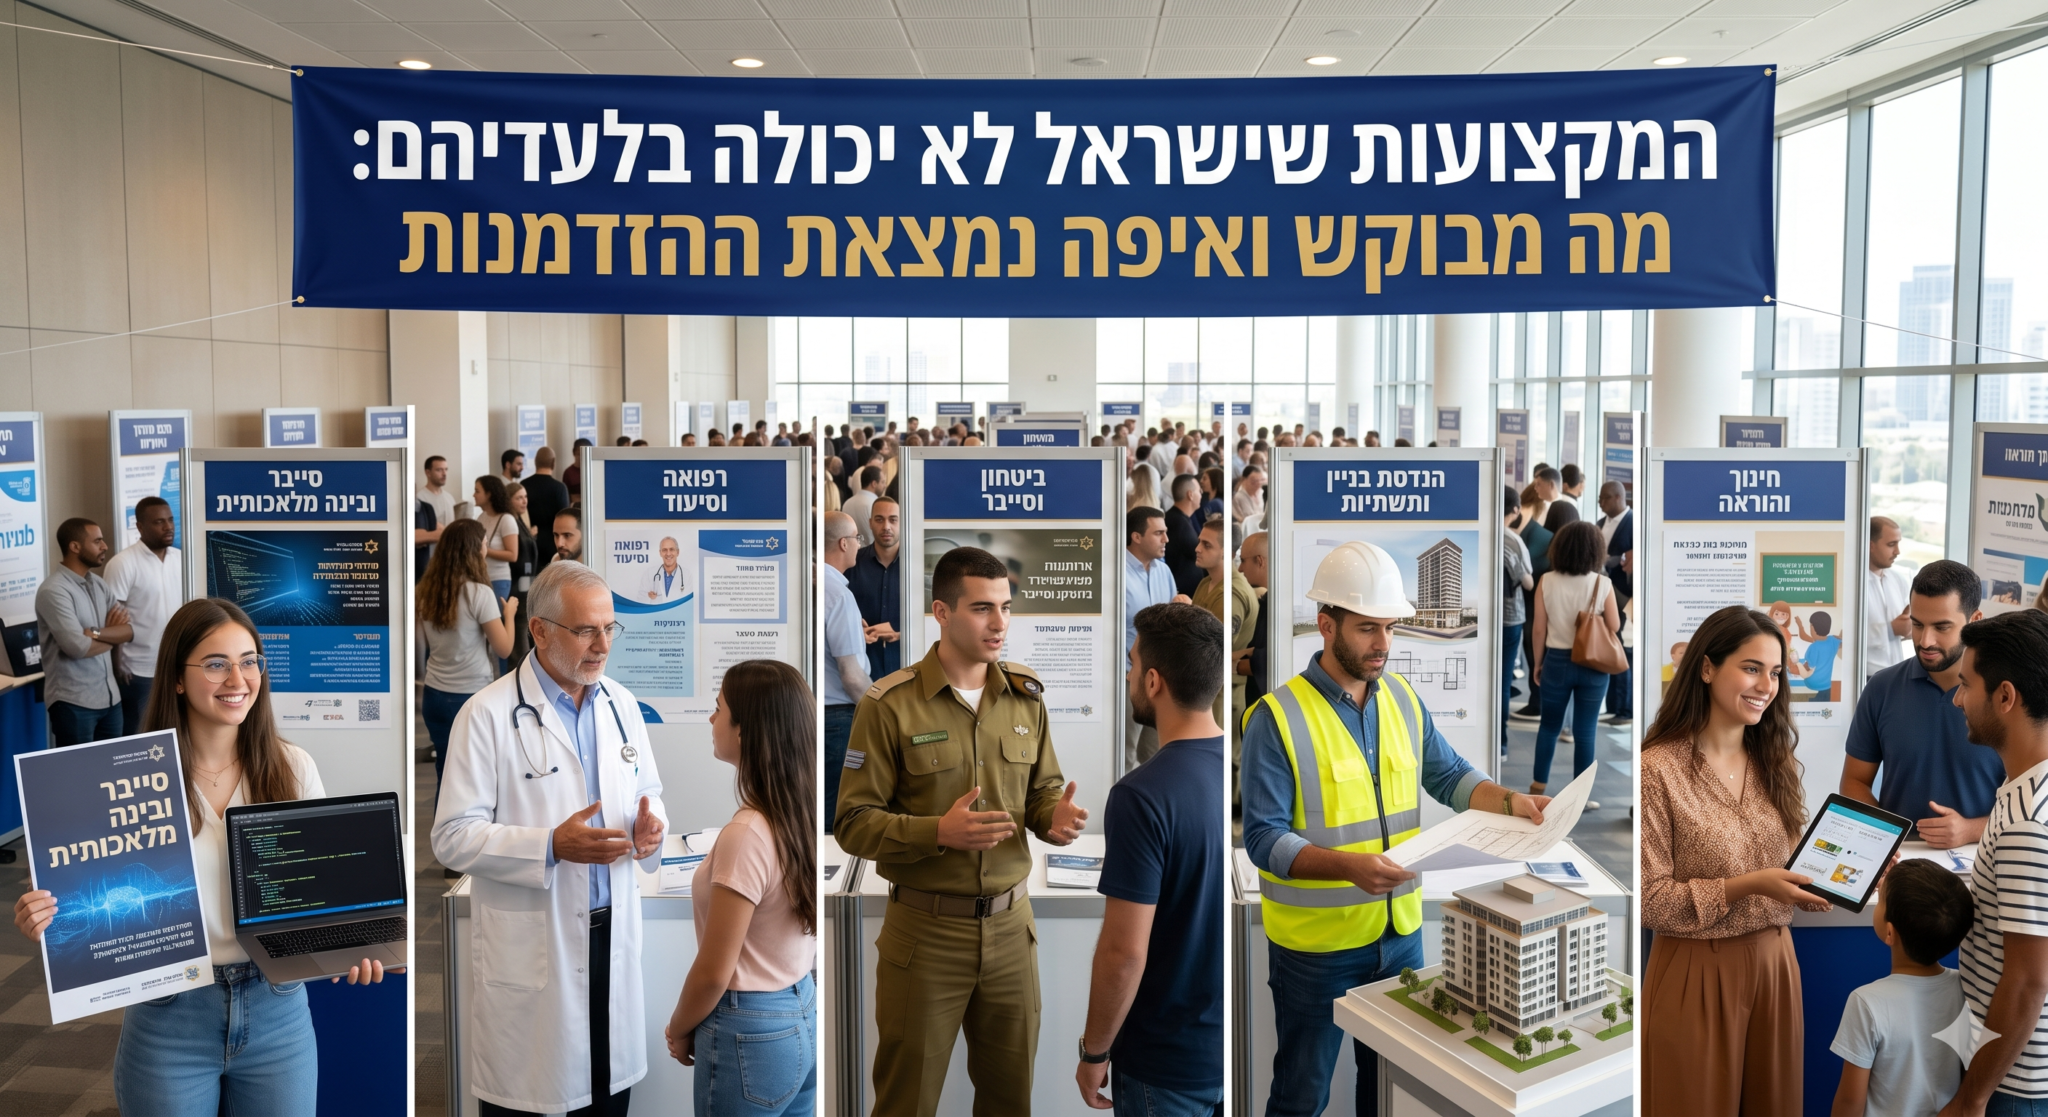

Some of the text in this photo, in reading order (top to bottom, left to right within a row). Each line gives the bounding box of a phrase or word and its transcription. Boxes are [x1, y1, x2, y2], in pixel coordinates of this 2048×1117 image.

[353, 109, 1718, 199] המקצועות שישראל לא יכולה בלעדיהם:
[399, 211, 1671, 294] מה מבוקש ואיפה נמצאת ההזדמנות
[268, 469, 323, 488] סייבר
[663, 469, 727, 488] רפואה
[981, 469, 1047, 492] ביטחון
[1327, 470, 1446, 493] הנדסת בניין
[1729, 469, 1781, 493] חינוך
[216, 490, 376, 513] ובינה מלאכותית
[662, 494, 728, 512] וסיעוד
[981, 493, 1044, 512] וסייבר
[1340, 494, 1430, 513] ותשתיות
[1719, 494, 1791, 513] והוראה
[613, 553, 649, 564] וסיעוד
[100, 771, 170, 802] סייבר
[110, 800, 173, 828] ובינה
[48, 828, 178, 868] מלאכותית
